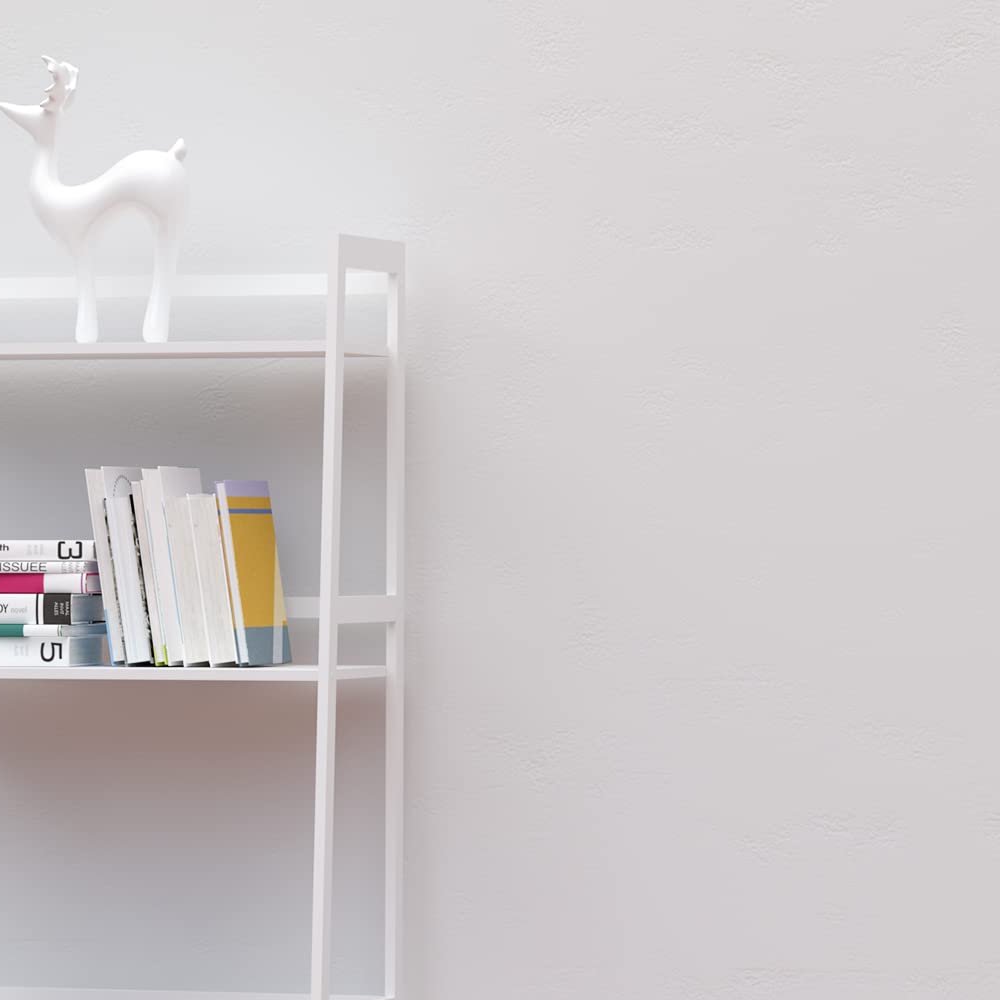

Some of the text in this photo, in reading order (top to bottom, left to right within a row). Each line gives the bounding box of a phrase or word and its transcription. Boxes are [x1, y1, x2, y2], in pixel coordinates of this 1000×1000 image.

[57, 541, 82, 560] 3
[0, 561, 47, 572] ISSUEE
[40, 642, 63, 662] 5
